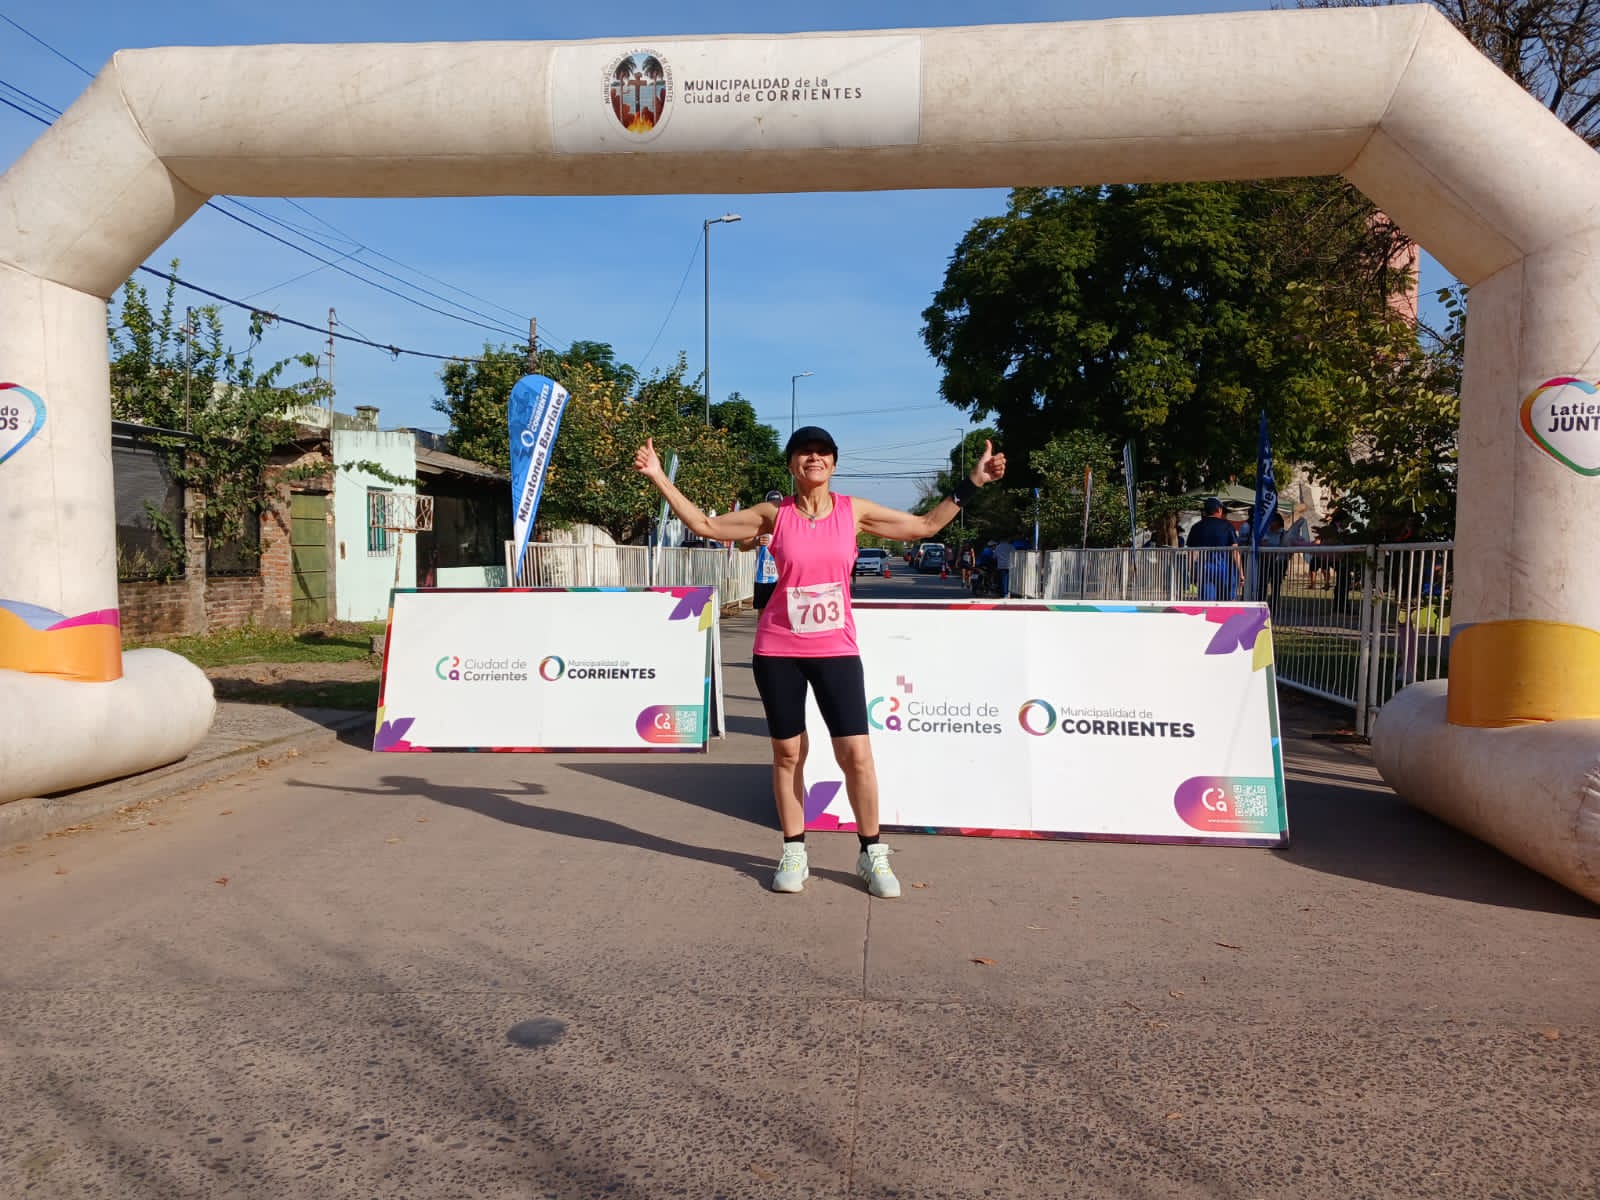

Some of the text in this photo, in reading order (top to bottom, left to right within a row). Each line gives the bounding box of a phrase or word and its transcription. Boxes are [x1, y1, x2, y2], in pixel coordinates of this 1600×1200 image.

[684, 76, 828, 91] MUNICIPALIDAD de la
[684, 87, 862, 104] Ciudad de CORRIENTES
[518, 451, 545, 522] Maratones
[539, 392, 565, 449] Barriales
[797, 601, 840, 625] 703
[464, 658, 527, 670] Ciudad de
[567, 659, 618, 669] Municipalidad
[463, 670, 528, 682] Corrientes
[567, 668, 656, 680] CORRIENTES
[907, 701, 999, 717] Ciudad de
[1060, 706, 1153, 719] Municipalidad de
[907, 718, 1002, 734] Corrientes
[1061, 719, 1196, 738] CORRIENTES
